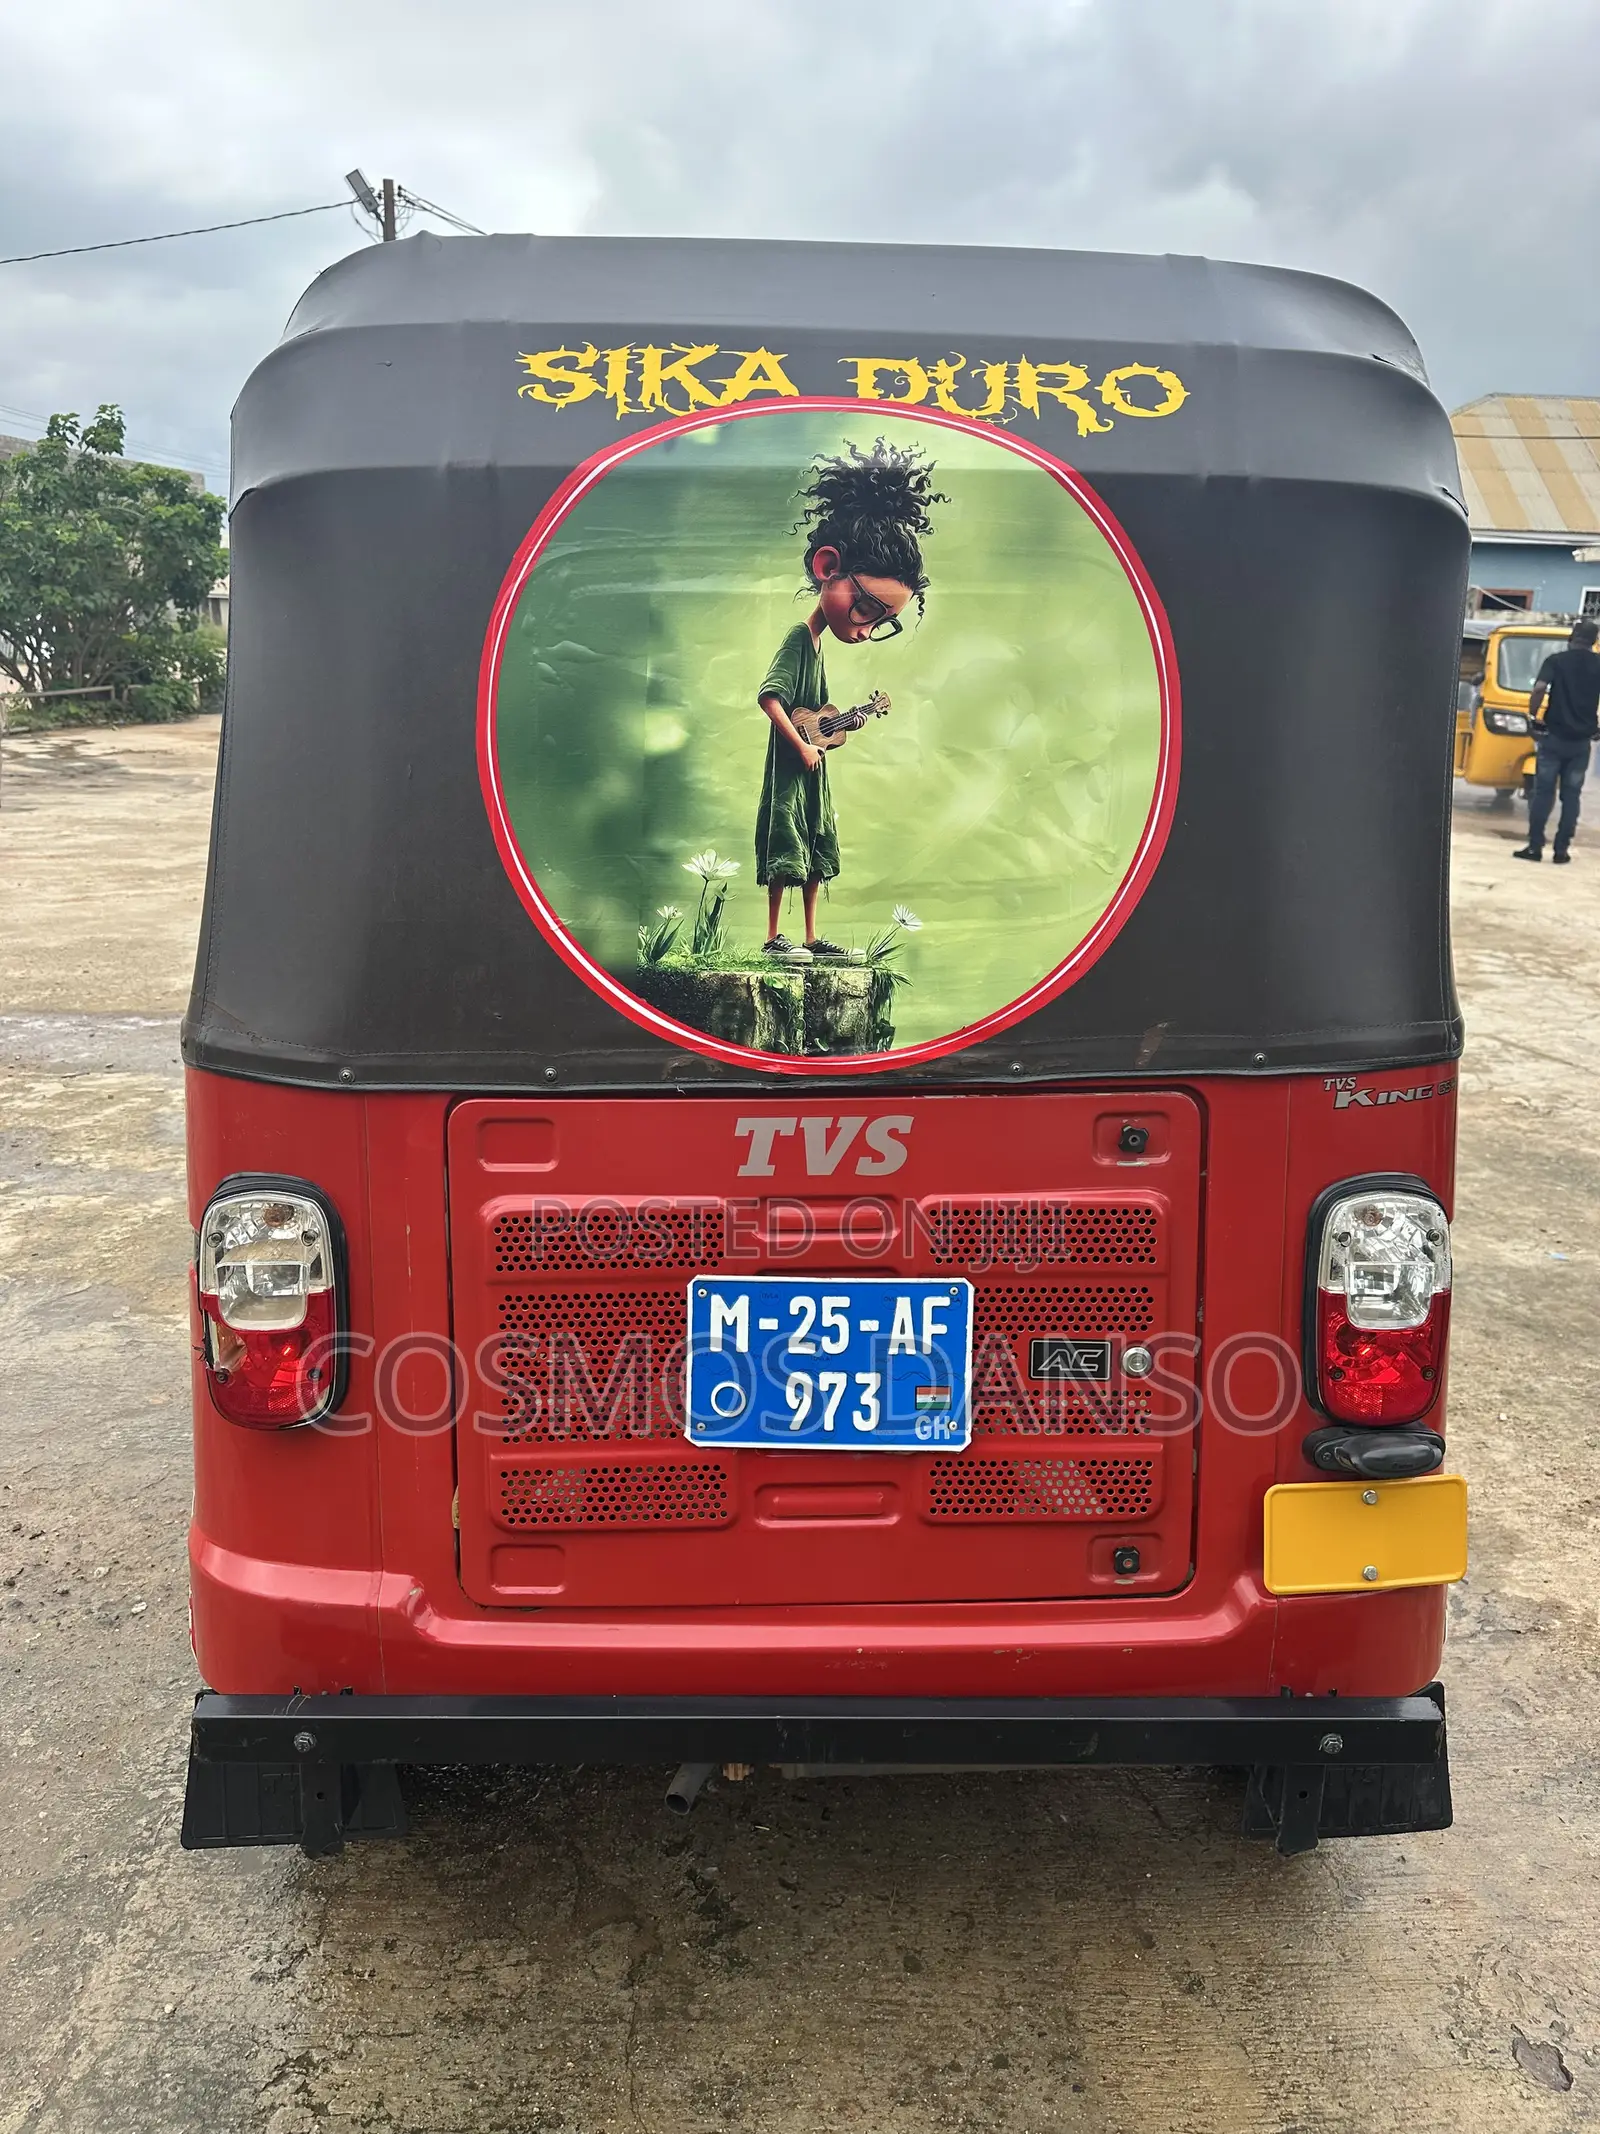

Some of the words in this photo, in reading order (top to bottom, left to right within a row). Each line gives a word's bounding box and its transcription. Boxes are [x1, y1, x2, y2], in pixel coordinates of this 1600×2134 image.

[514, 341, 800, 421] SIKA
[837, 351, 1191, 437] DURO
[1323, 1076, 1357, 1091] TVS
[734, 1115, 915, 1177] TVS
[1037, 1348, 1105, 1372] AC
[785, 1371, 881, 1432] 973
[914, 1414, 951, 1440] GH
